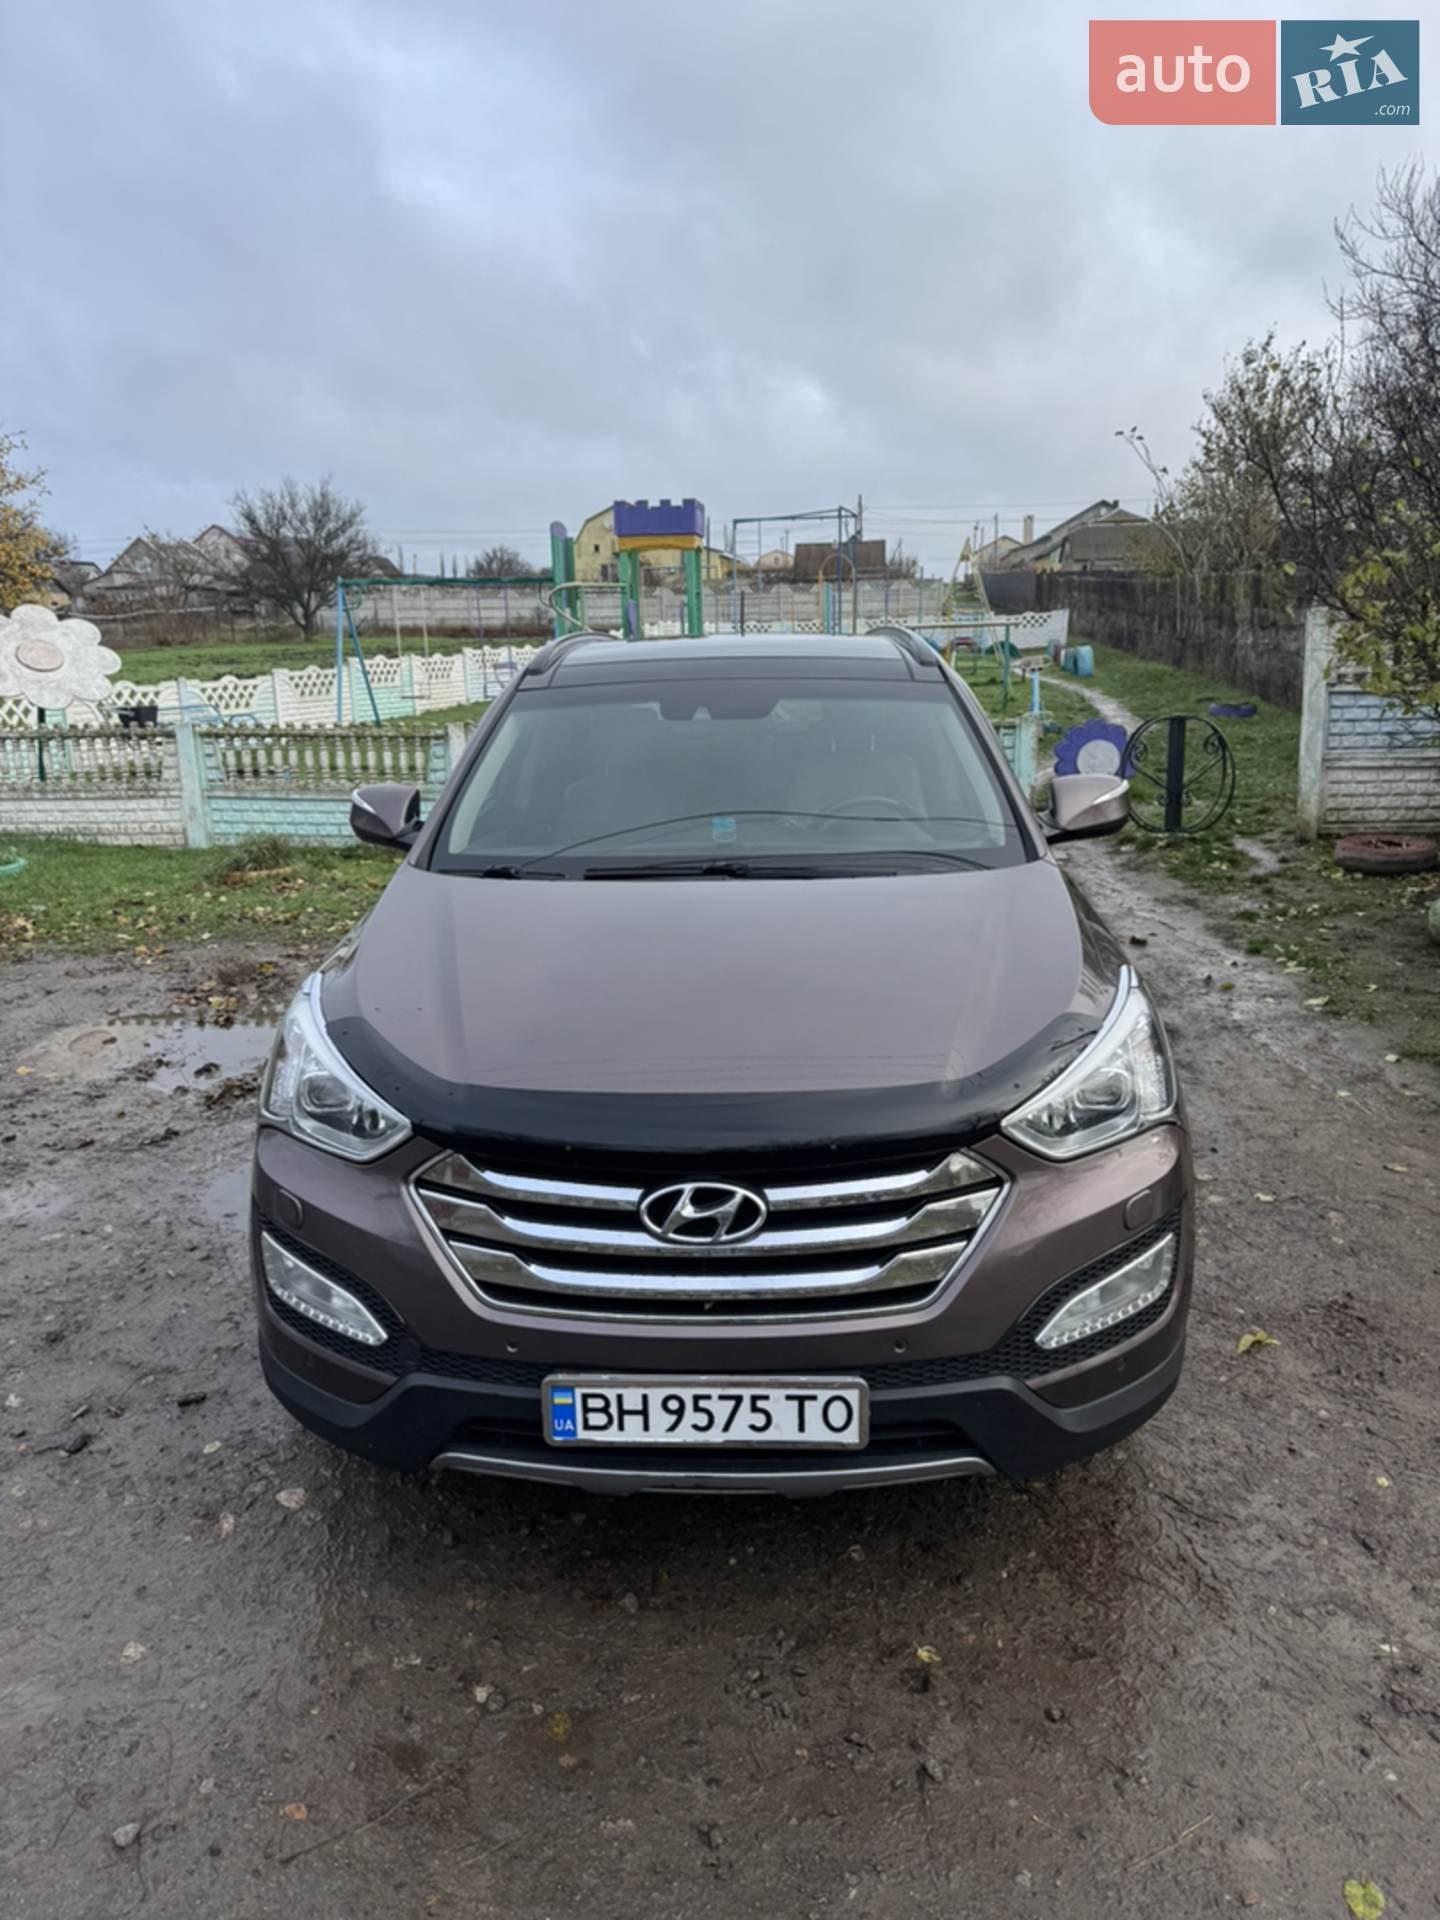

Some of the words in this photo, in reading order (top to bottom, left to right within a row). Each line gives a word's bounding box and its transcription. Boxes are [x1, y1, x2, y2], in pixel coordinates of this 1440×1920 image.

[554, 1419, 575, 1431] UA
[580, 1393, 650, 1432] BH
[661, 1393, 773, 1433] 9575
[785, 1394, 854, 1433] TO
